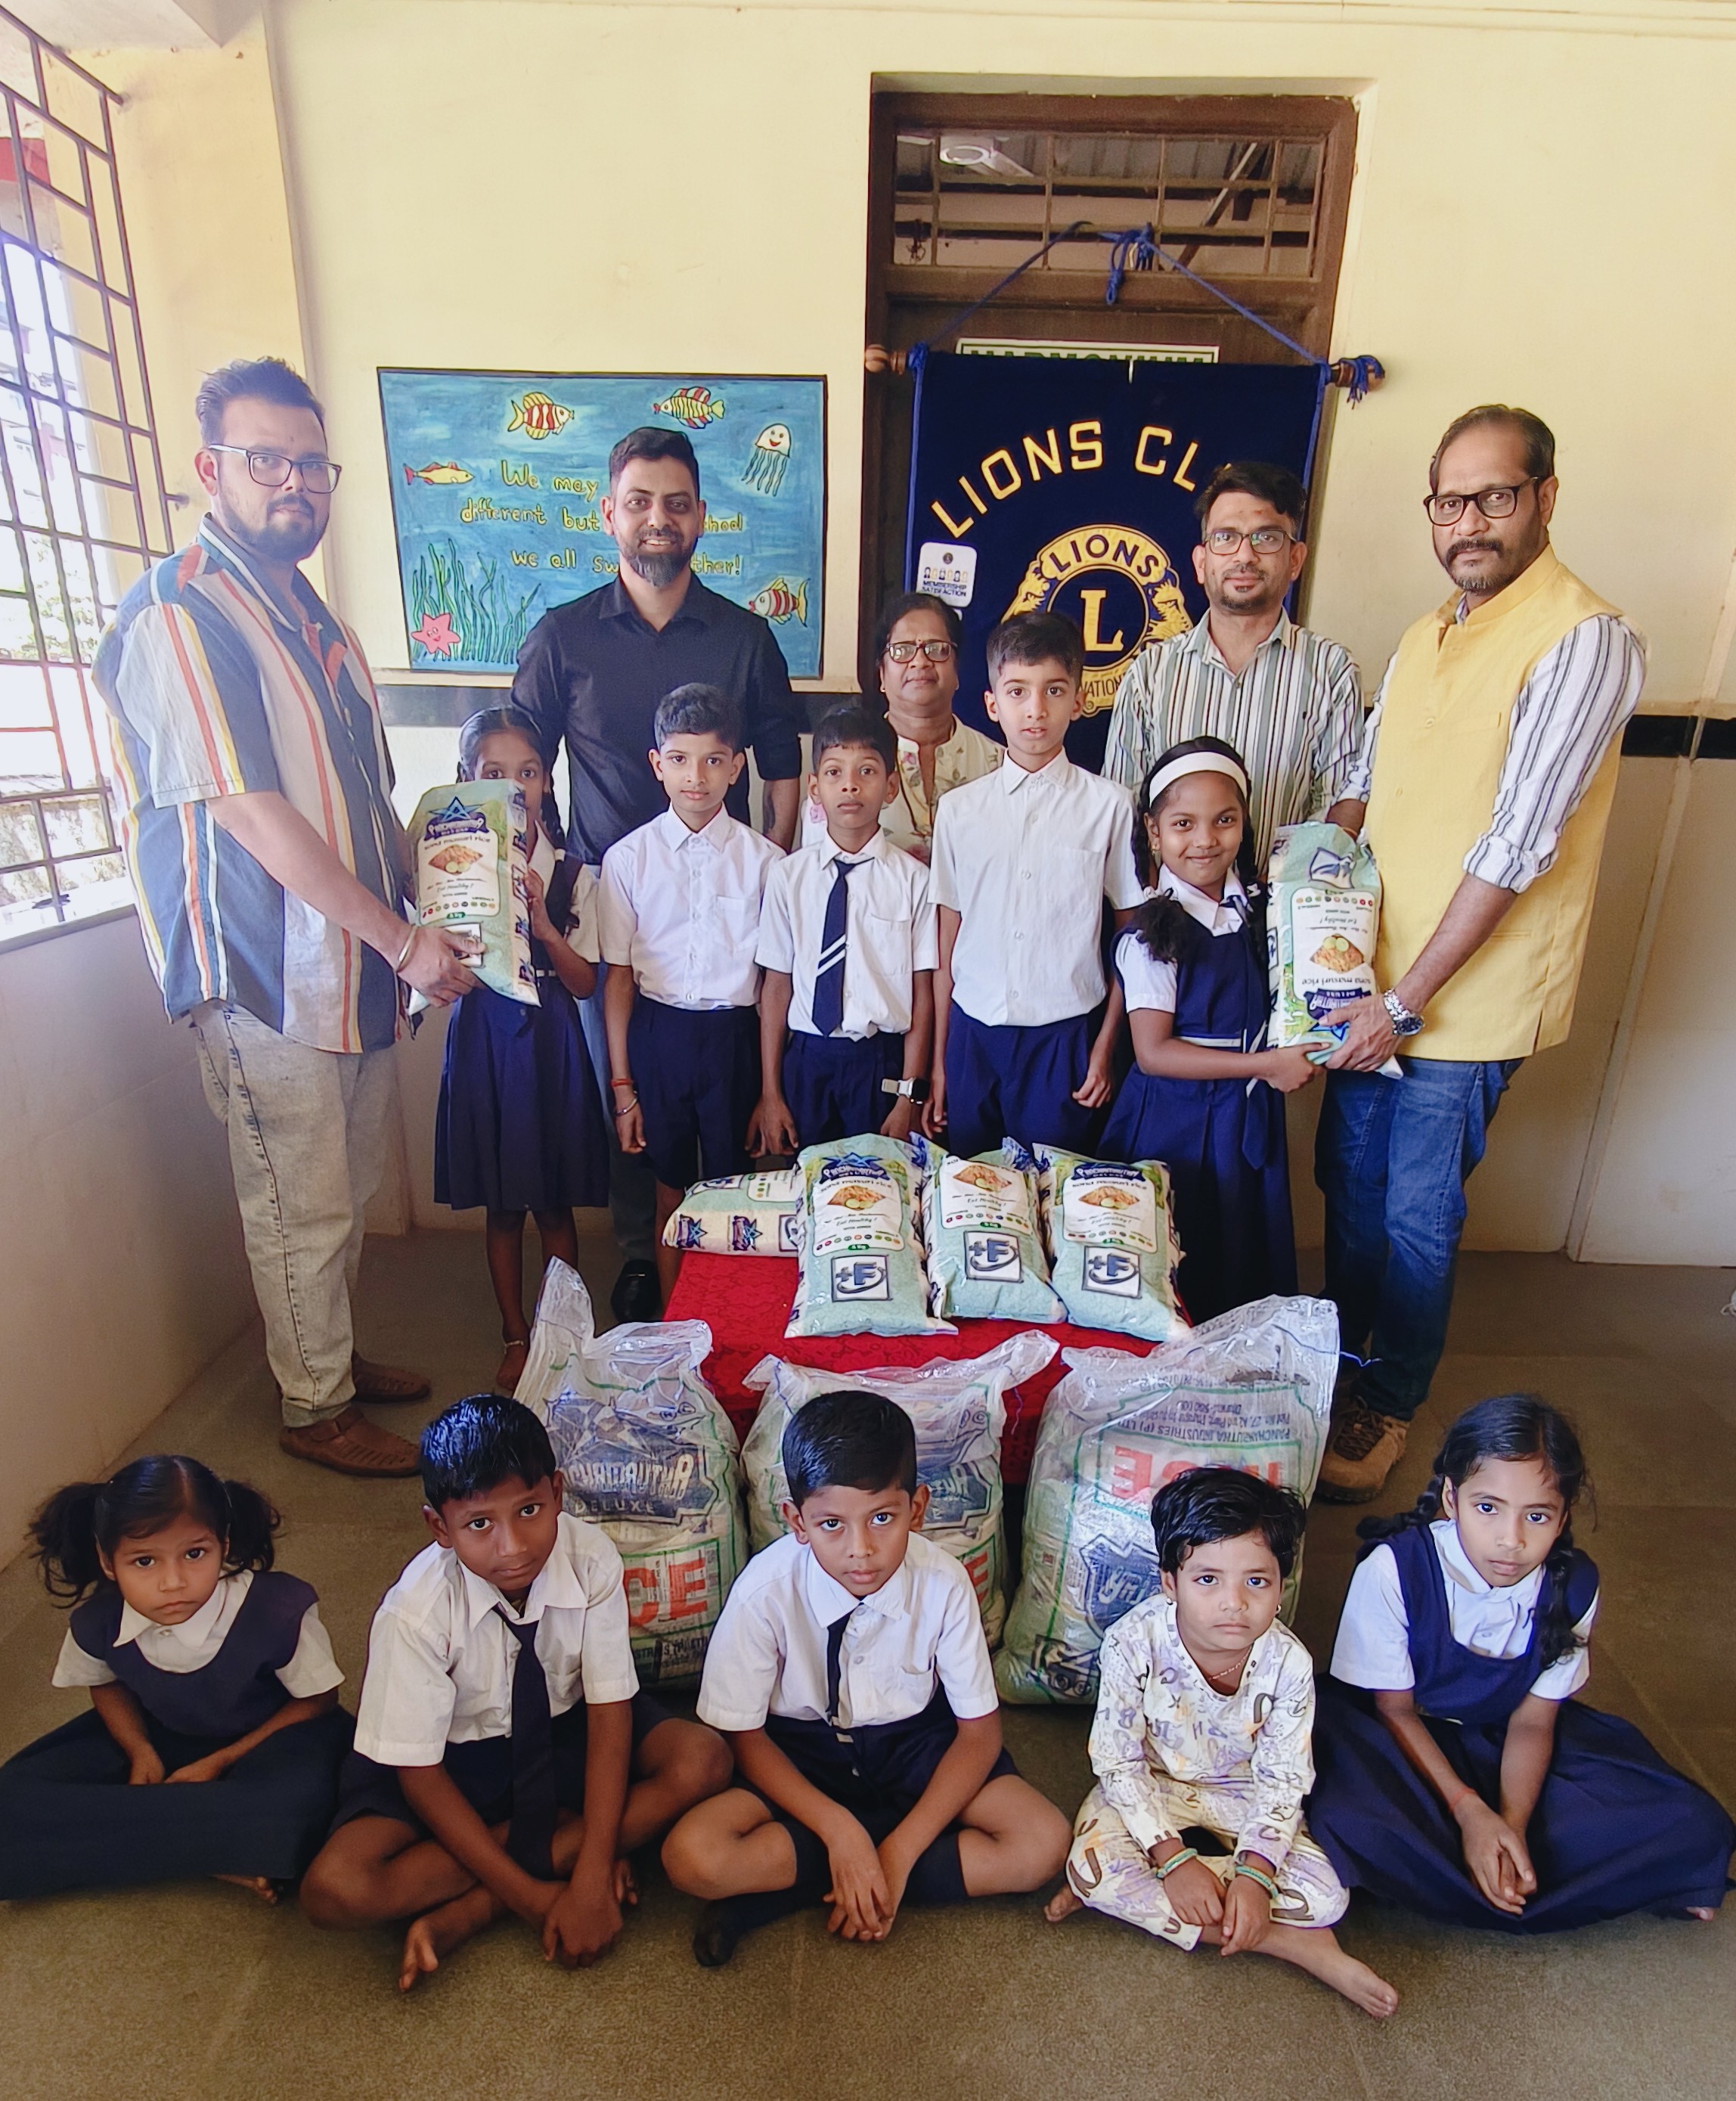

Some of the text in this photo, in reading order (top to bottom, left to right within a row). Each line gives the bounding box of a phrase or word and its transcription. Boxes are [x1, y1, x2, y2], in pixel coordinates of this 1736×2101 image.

[501, 459, 600, 503] We may
[931, 421, 1199, 538] LIONS CL
[460, 497, 743, 532] different but hool
[510, 548, 539, 568] we
[550, 548, 577, 569] all
[690, 551, 740, 576] ther!
[1048, 532, 1161, 585] LIONS
[1080, 589, 1124, 653] L
[575, 1496, 656, 1515] DELUXE
[623, 1557, 708, 1627] CE
